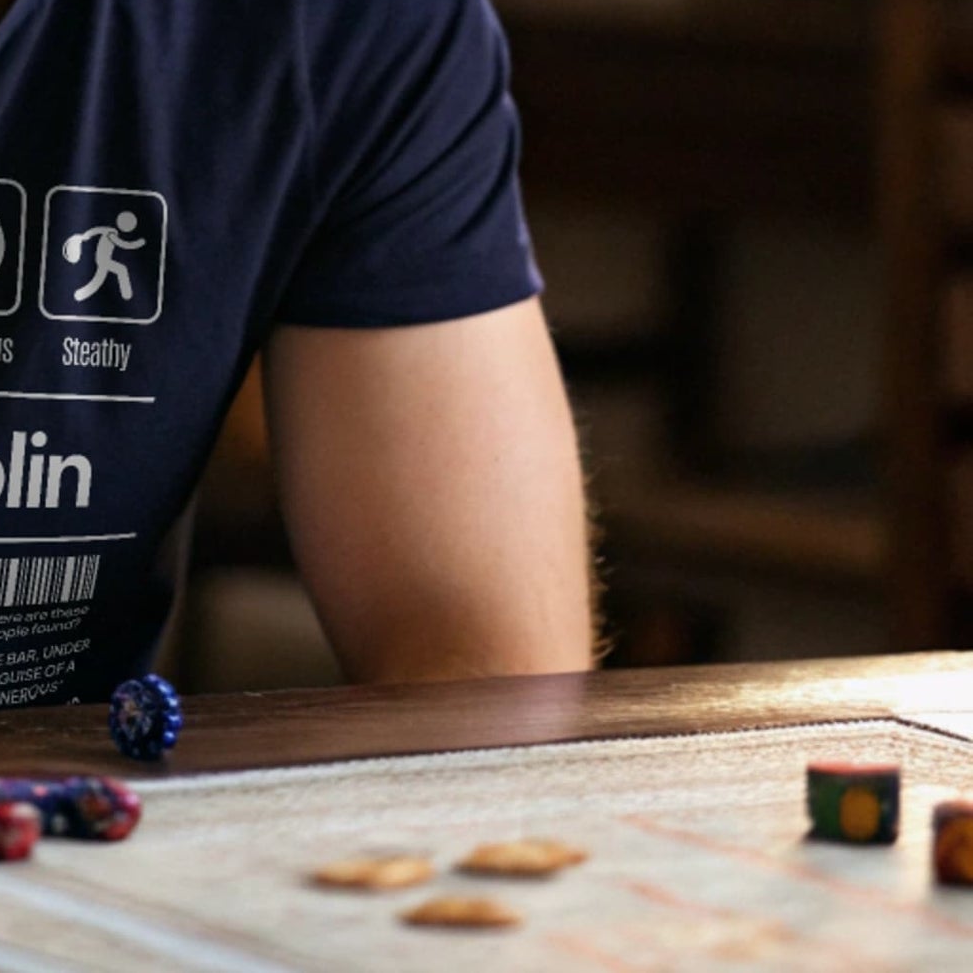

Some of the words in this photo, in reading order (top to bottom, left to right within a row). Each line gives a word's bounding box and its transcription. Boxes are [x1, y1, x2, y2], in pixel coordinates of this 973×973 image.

[62, 336, 131, 371] Steathy
[24, 611, 48, 622] are
[42, 638, 91, 660] UNDER
[43, 661, 65, 678] OF
[66, 660, 75, 672] A
